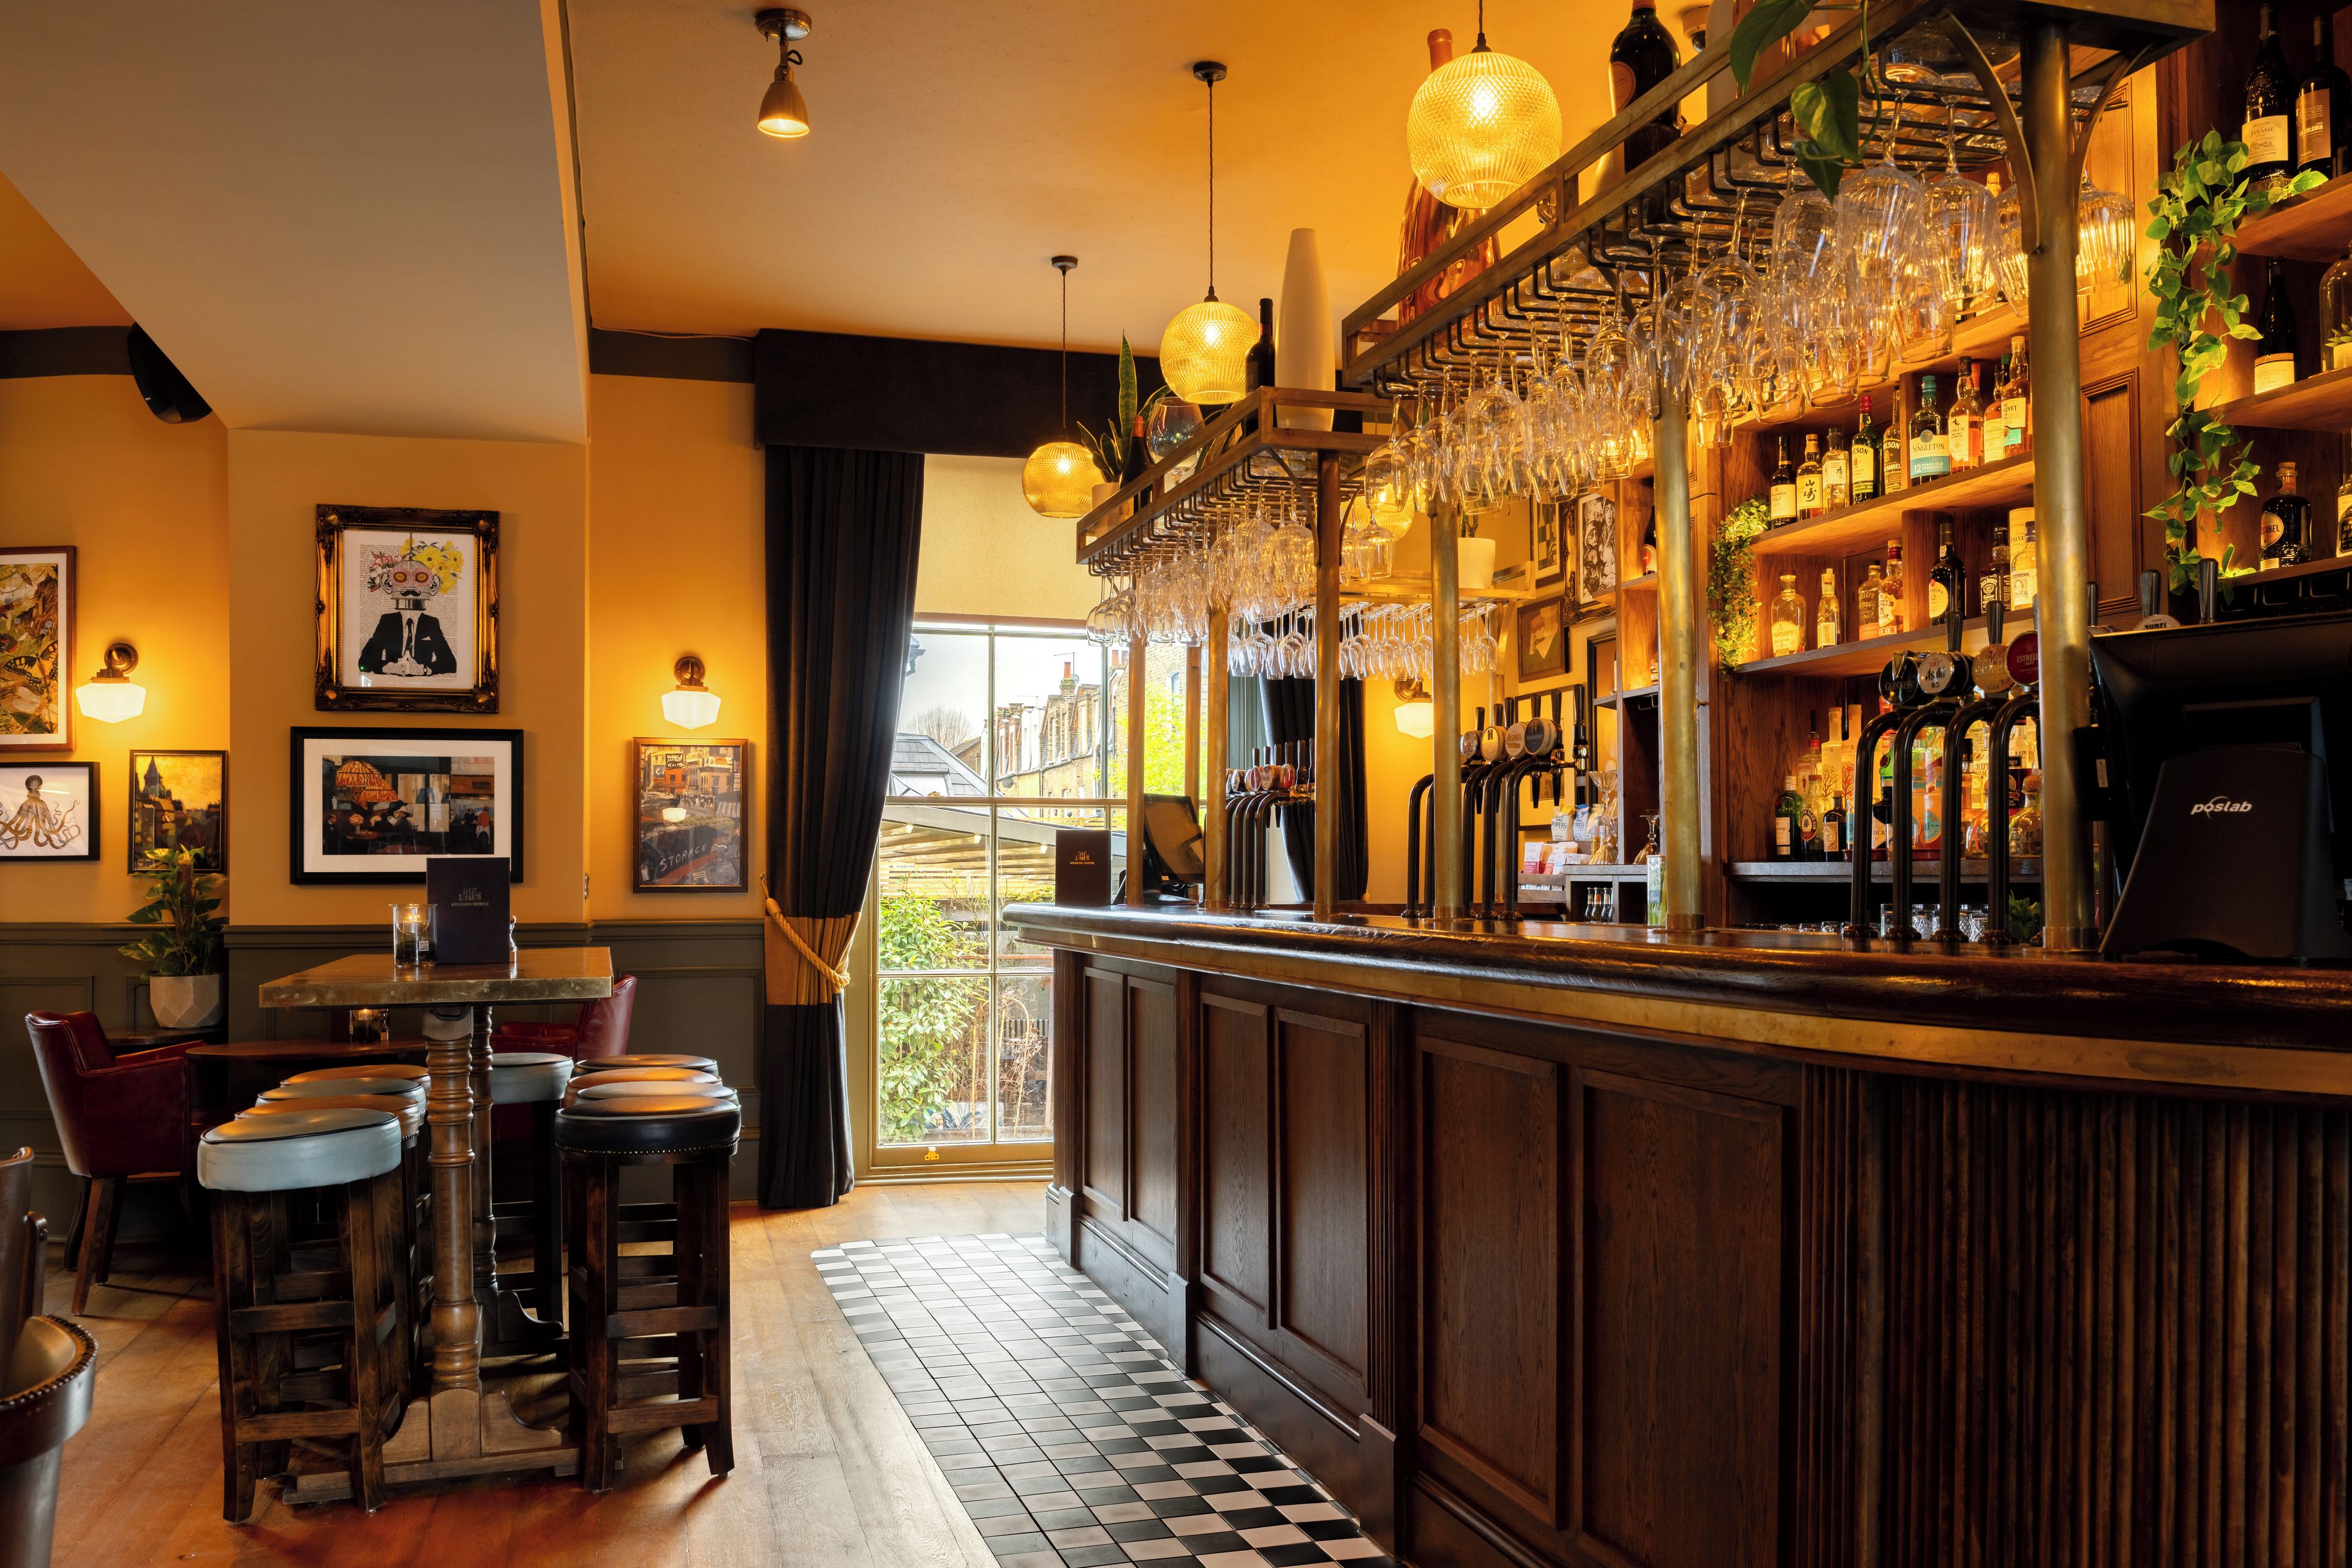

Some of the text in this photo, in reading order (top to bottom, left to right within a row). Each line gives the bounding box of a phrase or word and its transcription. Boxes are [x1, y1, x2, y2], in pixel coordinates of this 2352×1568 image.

[2250, 127, 2274, 137] JANASSE
[2304, 124, 2323, 135] COLONIA
[1885, 441, 1901, 450] ESON
[1912, 443, 1945, 453] SINGLETON
[1914, 464, 1921, 473] 12
[1925, 666, 1945, 681] Asahi
[1885, 680, 1913, 692] GUINNESS
[2190, 801, 2252, 815] poslab
[660, 844, 707, 872] STORAGE
